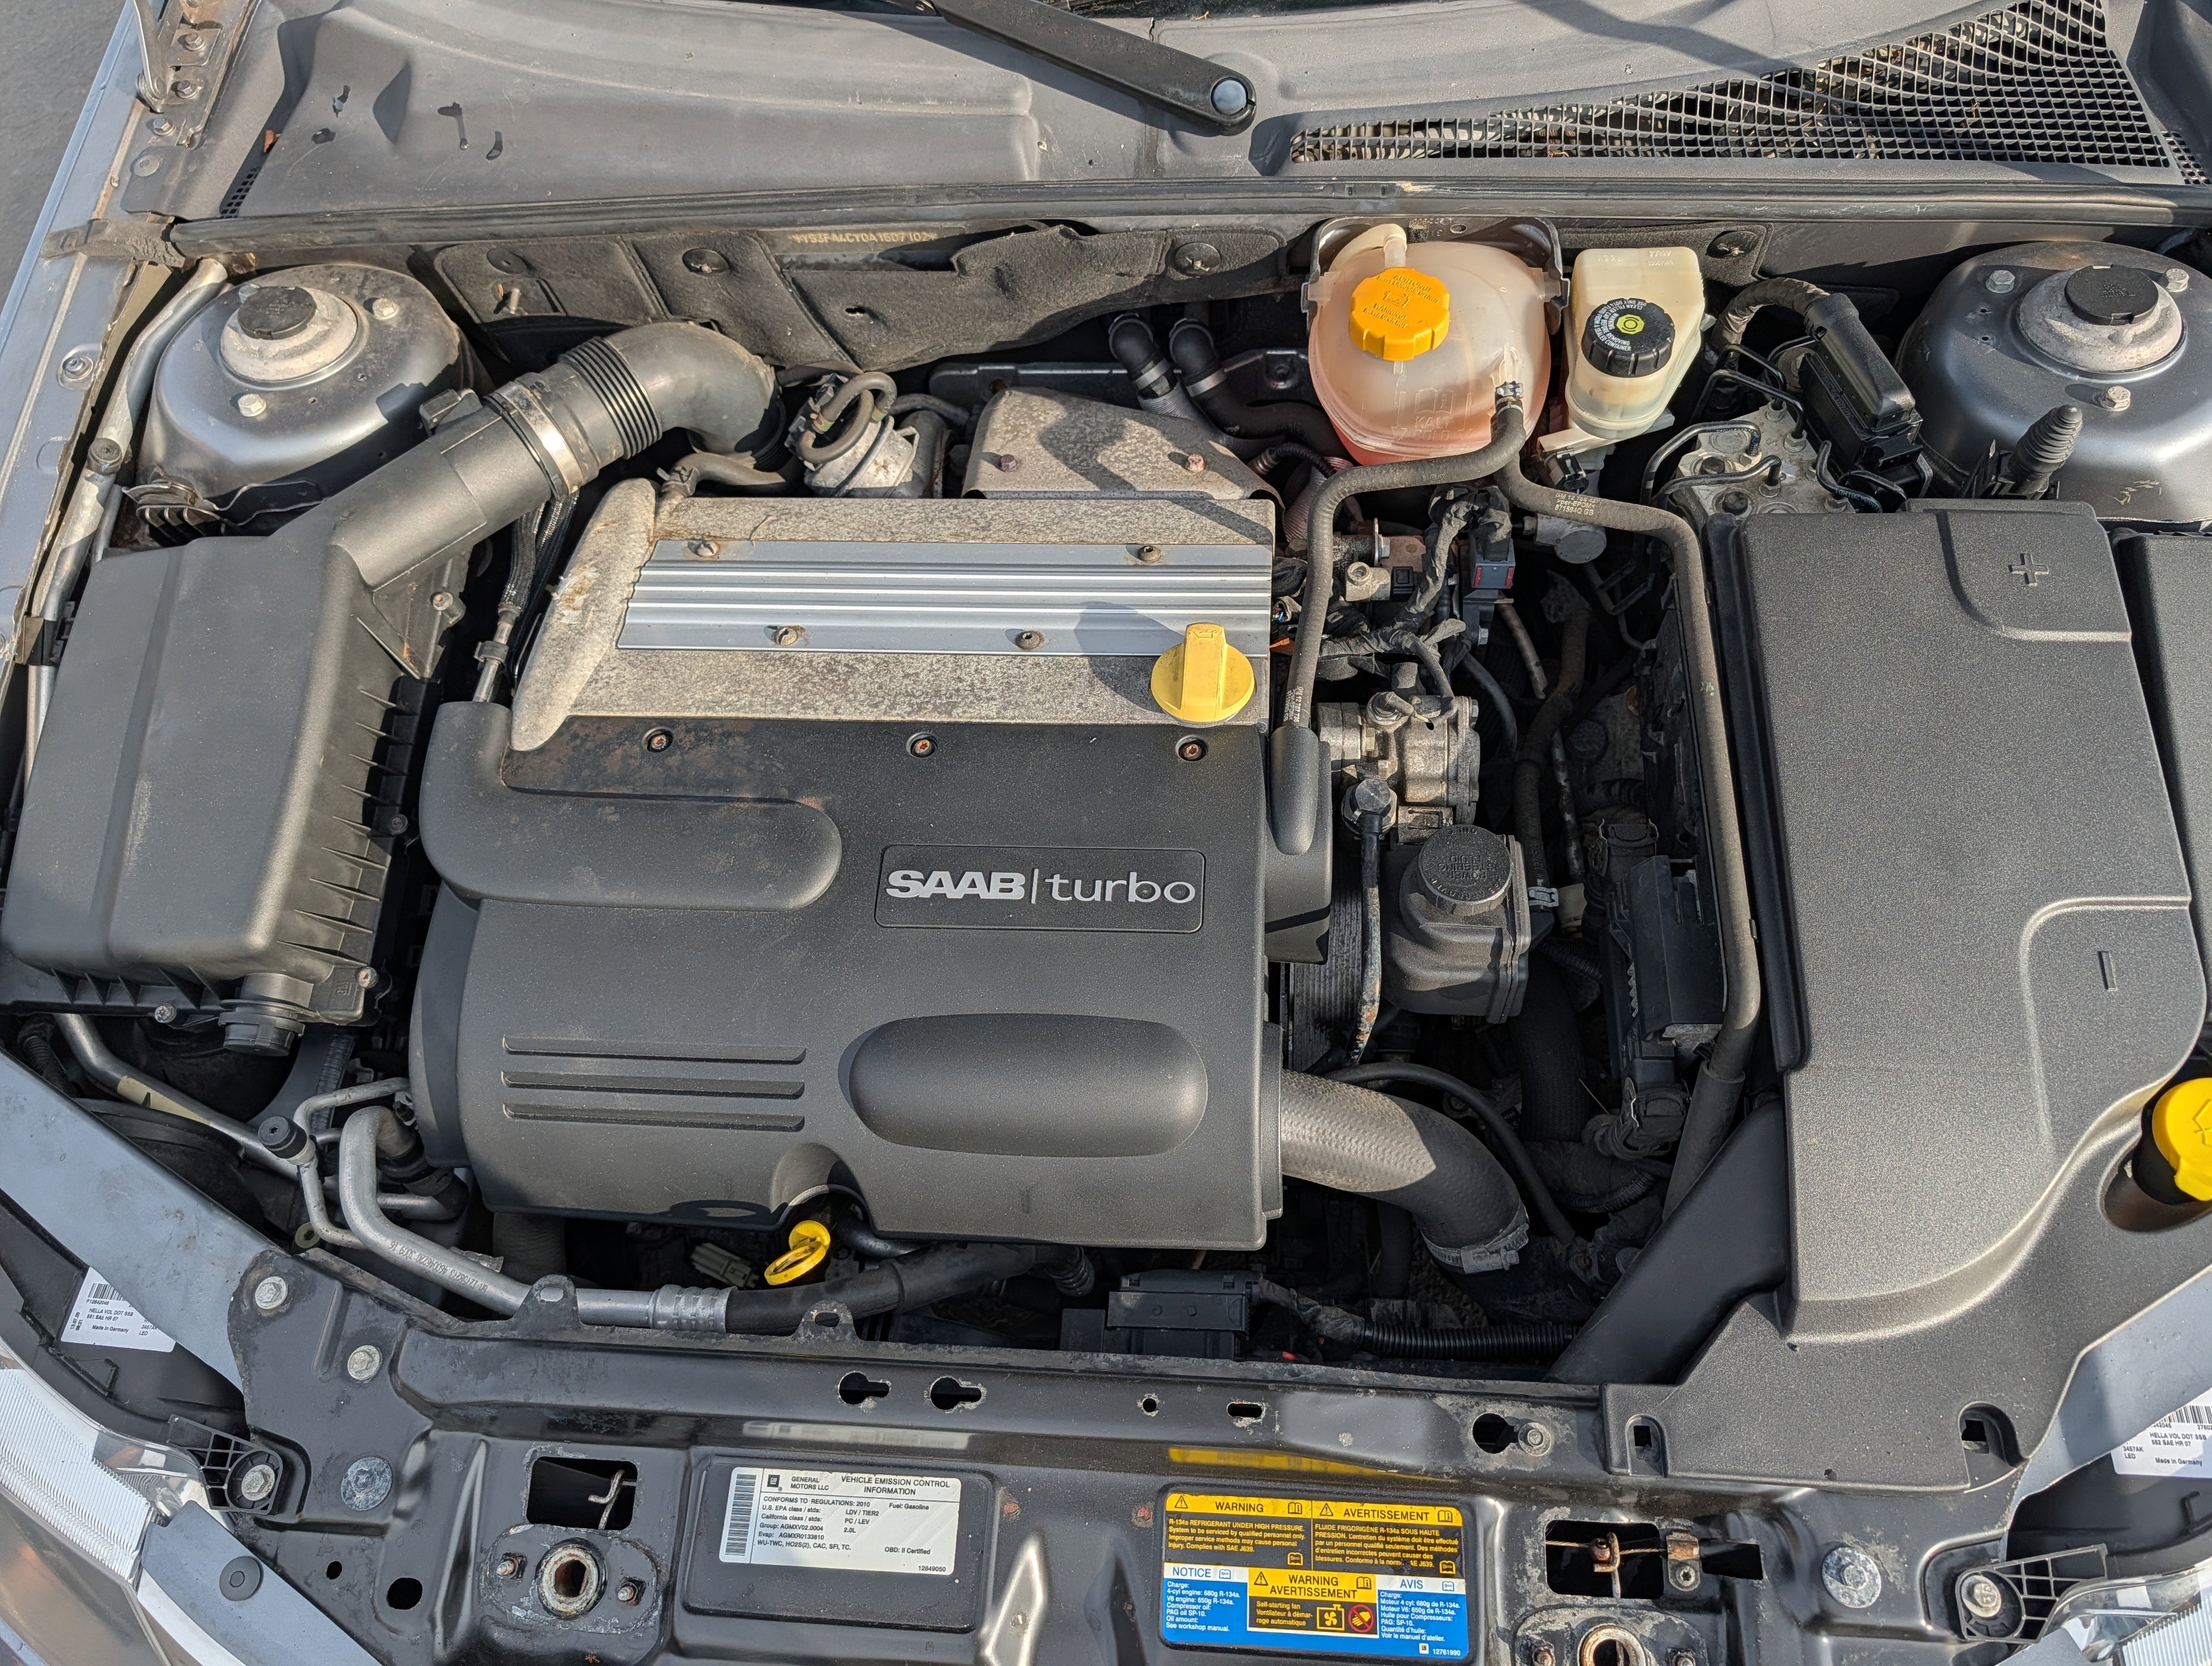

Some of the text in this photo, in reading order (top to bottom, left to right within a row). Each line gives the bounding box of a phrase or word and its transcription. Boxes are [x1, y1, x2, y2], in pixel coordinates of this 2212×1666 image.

[1598, 304, 1610, 315] FLUID
[1609, 305, 1625, 313] FILLER
[1593, 313, 1602, 324] FROM
[1603, 311, 1611, 319] CAP
[1608, 312, 1619, 330] WARNING
[1600, 319, 1609, 334] BEFORE
[1594, 328, 1607, 342] SEALED
[1605, 332, 1630, 346] REMOVING
[1604, 339, 1631, 351] CONTAINER
[1437, 863, 1496, 871] STEERING
[885, 869, 1195, 904] SAAB turbo
[2178, 1458, 2202, 1466] Germany
[841, 1476, 950, 1488] VEHICLE EMISSION CONTROL
[864, 1486, 916, 1495] INFORMATION
[811, 1498, 856, 1507] REGULATIONS:
[1215, 1501, 1264, 1513] WARNING
[1343, 1508, 1430, 1521] AVERTISSEMENT
[760, 1522, 824, 1532] Group: AGMXV02.0004
[1189, 1520, 1232, 1528] REFRIGERANT
[1168, 1526, 1189, 1534] System
[1168, 1534, 1194, 1542] Improper
[757, 1539, 784, 1548] WU-TWC,
[785, 1541, 812, 1549] HO2S(2),
[1186, 1542, 1213, 1550] Complies
[1173, 1567, 1211, 1578] NOTICE
[1167, 1581, 1189, 1589] Charge:
[1288, 1574, 1339, 1586] WARNING
[1400, 1579, 1423, 1590] AVIS
[1204, 1590, 1218, 1598] 680g
[1269, 1585, 1358, 1599] AVERTISSEMENT
[1197, 1597, 1212, 1605] 650g
[1256, 1600, 1290, 1610] Self-starting
[1270, 1618, 1306, 1627] automatique
[1432, 1648, 1461, 1656] 12761990
